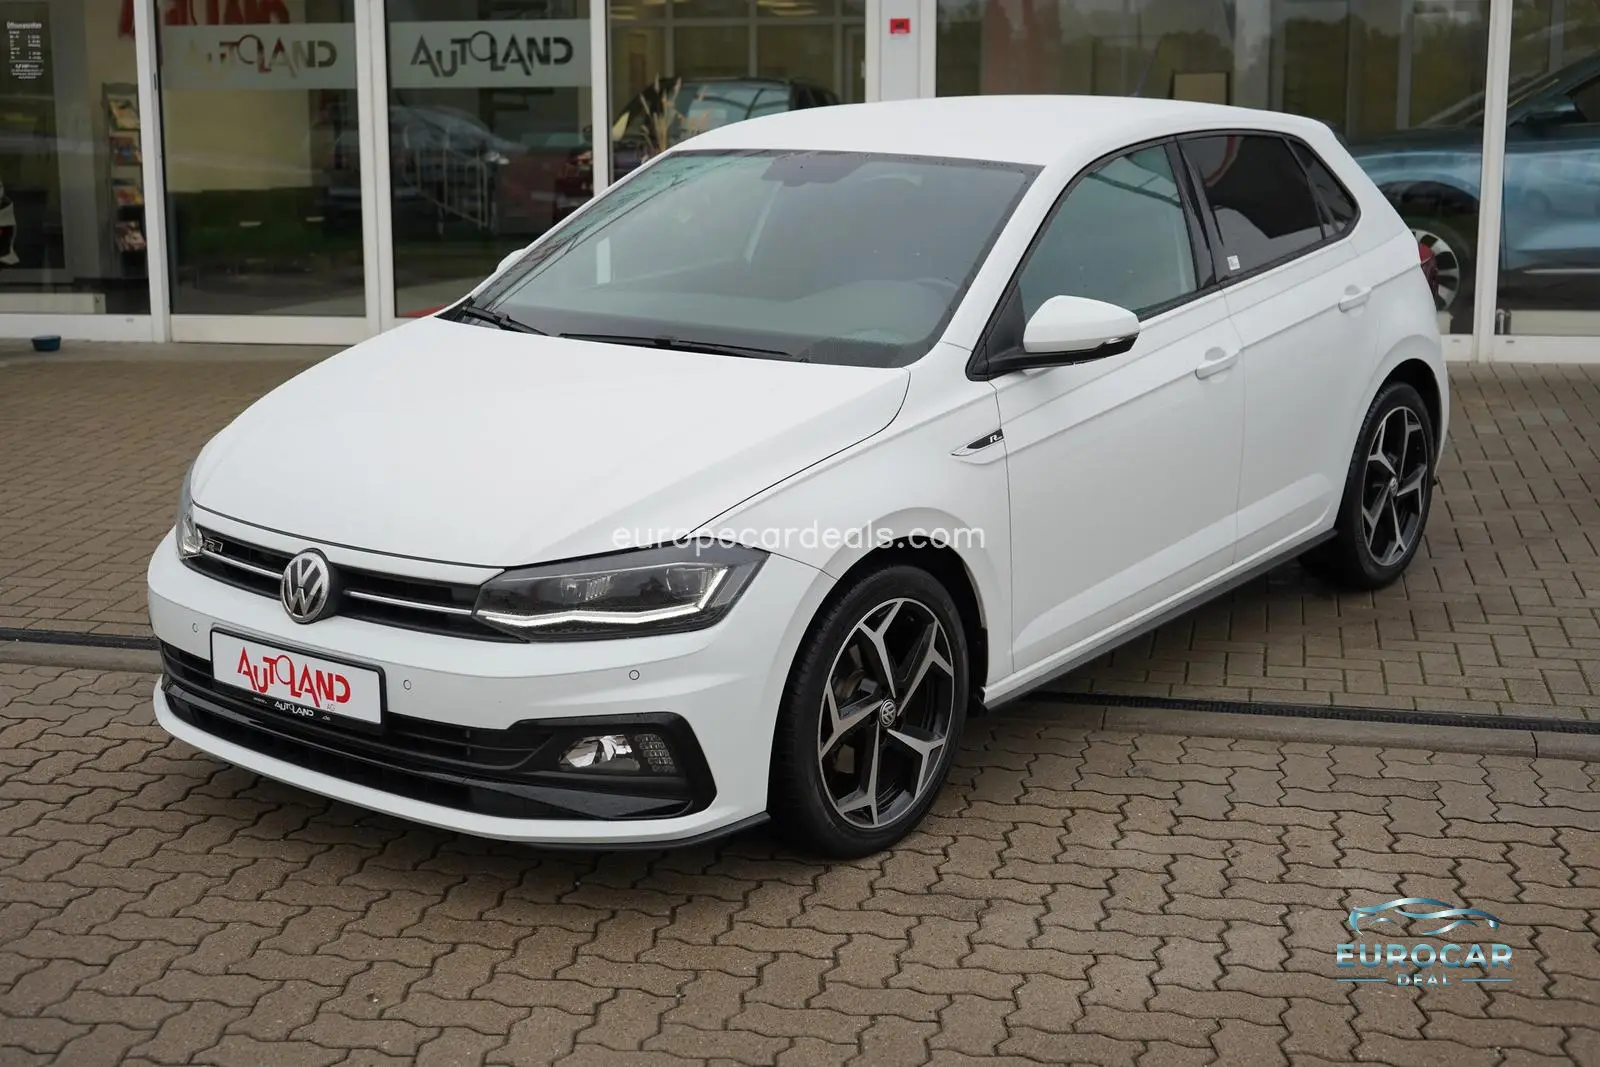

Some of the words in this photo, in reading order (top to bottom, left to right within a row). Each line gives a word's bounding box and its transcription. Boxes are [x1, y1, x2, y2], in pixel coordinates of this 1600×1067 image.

[181, 34, 337, 79] TOLAND
[410, 31, 574, 78] AUTOLAND
[237, 646, 351, 708] AUTOLAND
[274, 701, 314, 717] AUTOLAND
